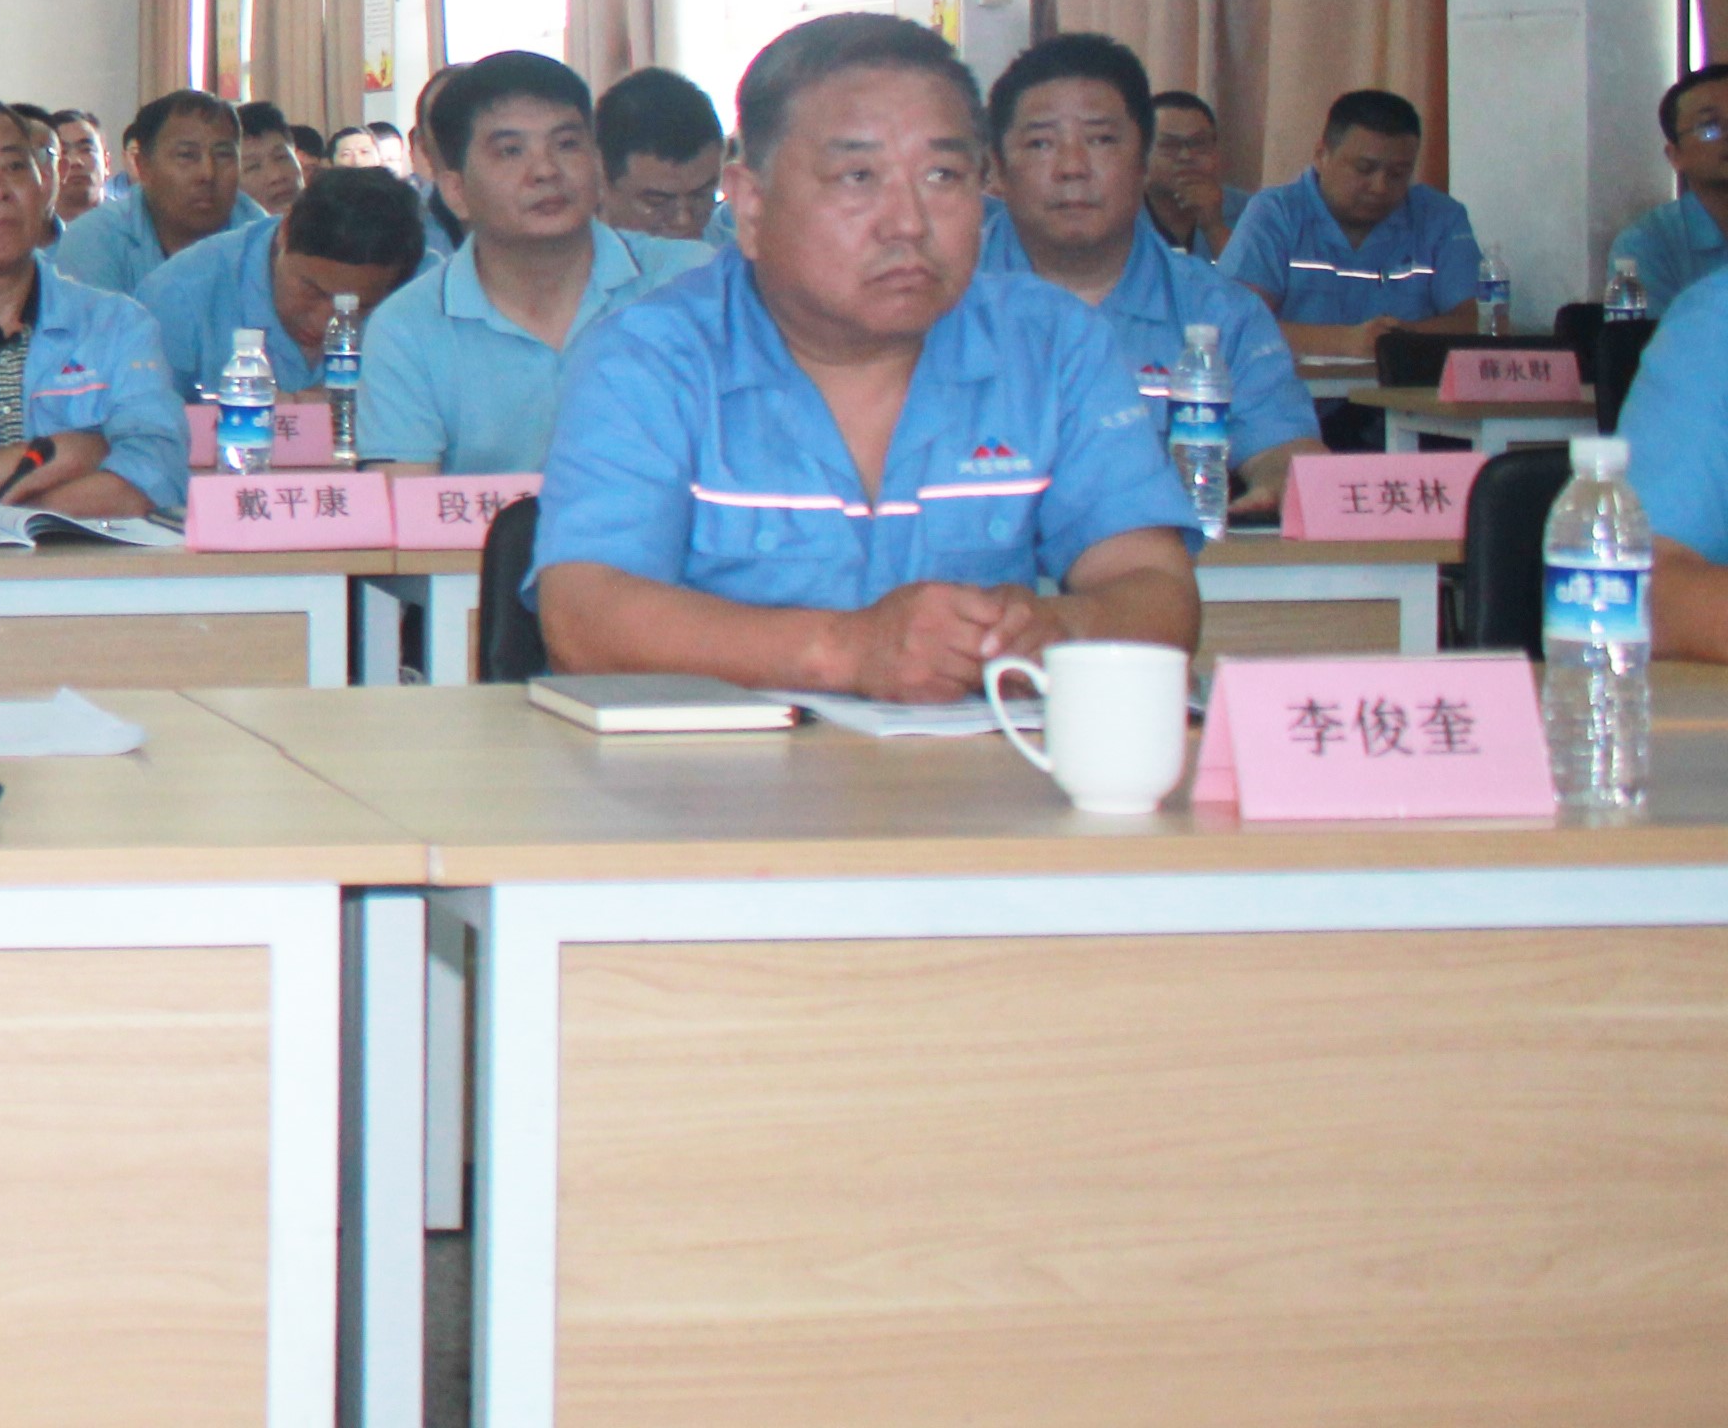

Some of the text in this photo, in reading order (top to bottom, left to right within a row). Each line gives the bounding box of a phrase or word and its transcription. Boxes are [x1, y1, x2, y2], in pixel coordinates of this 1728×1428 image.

[235, 486, 350, 521] 戴平康
[438, 490, 533, 524] 段秋
[1339, 478, 1452, 515] 王英林
[1286, 696, 1482, 759] 李俊奎
